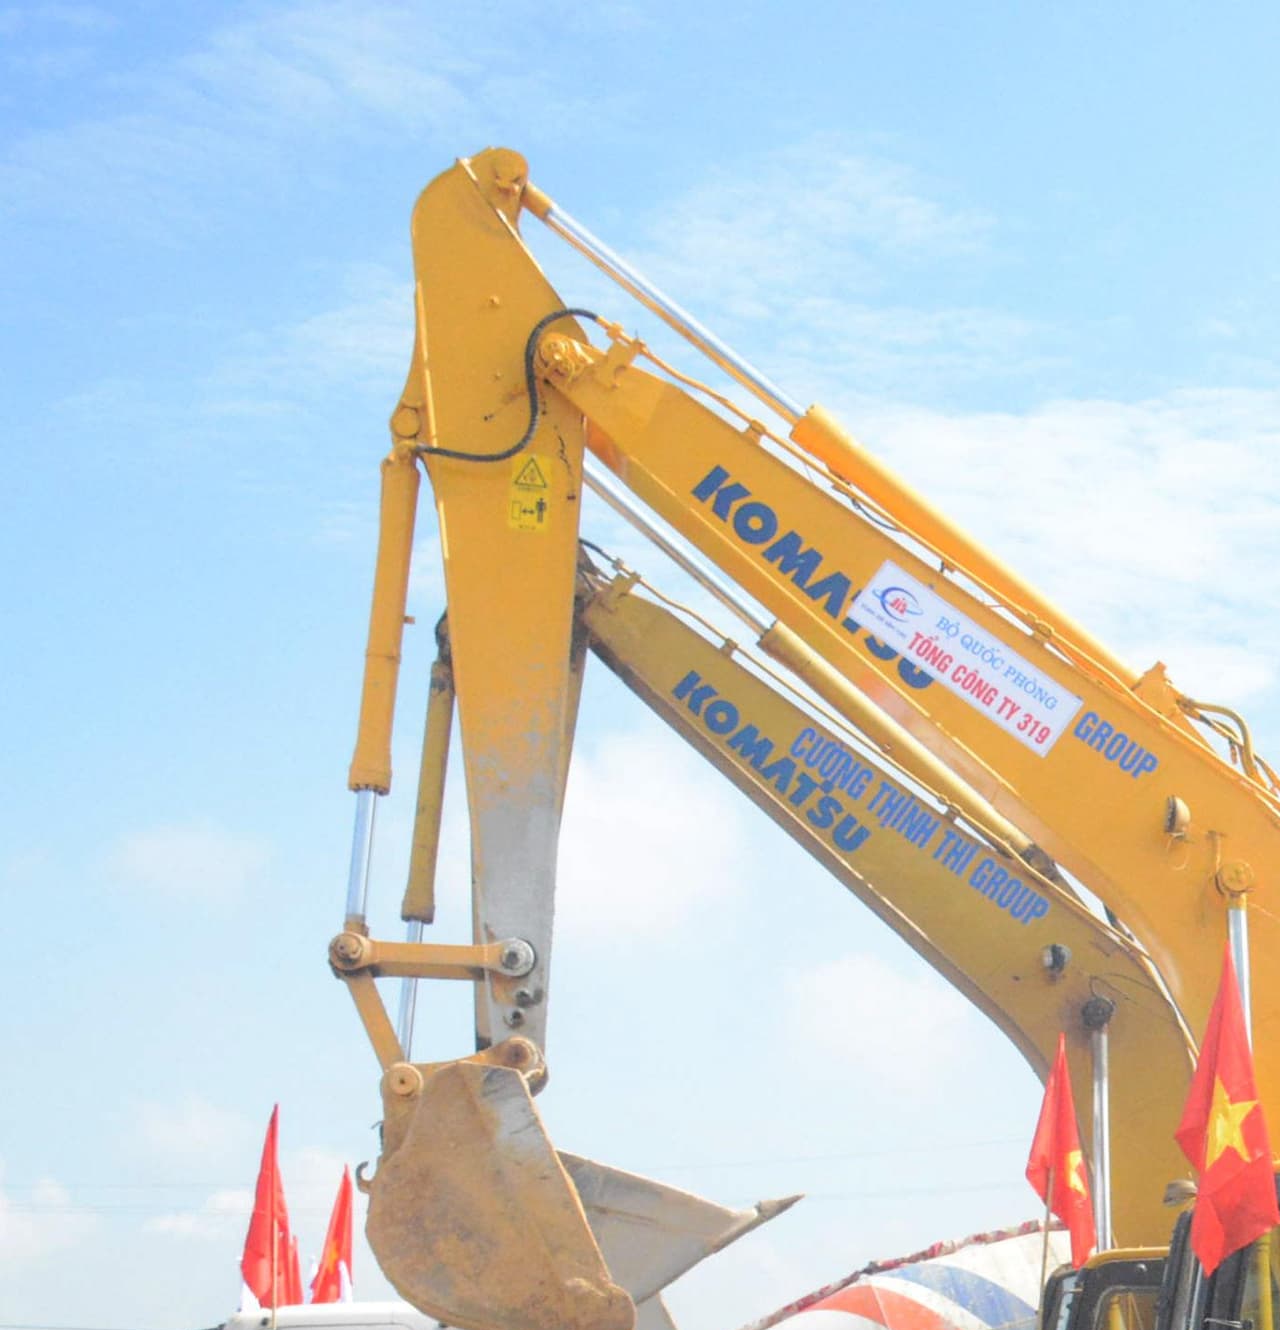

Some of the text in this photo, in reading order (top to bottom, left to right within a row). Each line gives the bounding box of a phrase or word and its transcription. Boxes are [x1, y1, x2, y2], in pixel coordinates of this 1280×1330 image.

[691, 464, 935, 689] KOMA
[907, 631, 1051, 745] TỔNG CÔNG TY 319
[936, 616, 961, 639] BỘ
[960, 633, 1005, 671] QUỐC
[1002, 665, 1059, 711] PHÒNG
[672, 670, 870, 854] KOMATSU
[1073, 711, 1159, 779] GROUP
[967, 857, 1051, 926] GROUP
